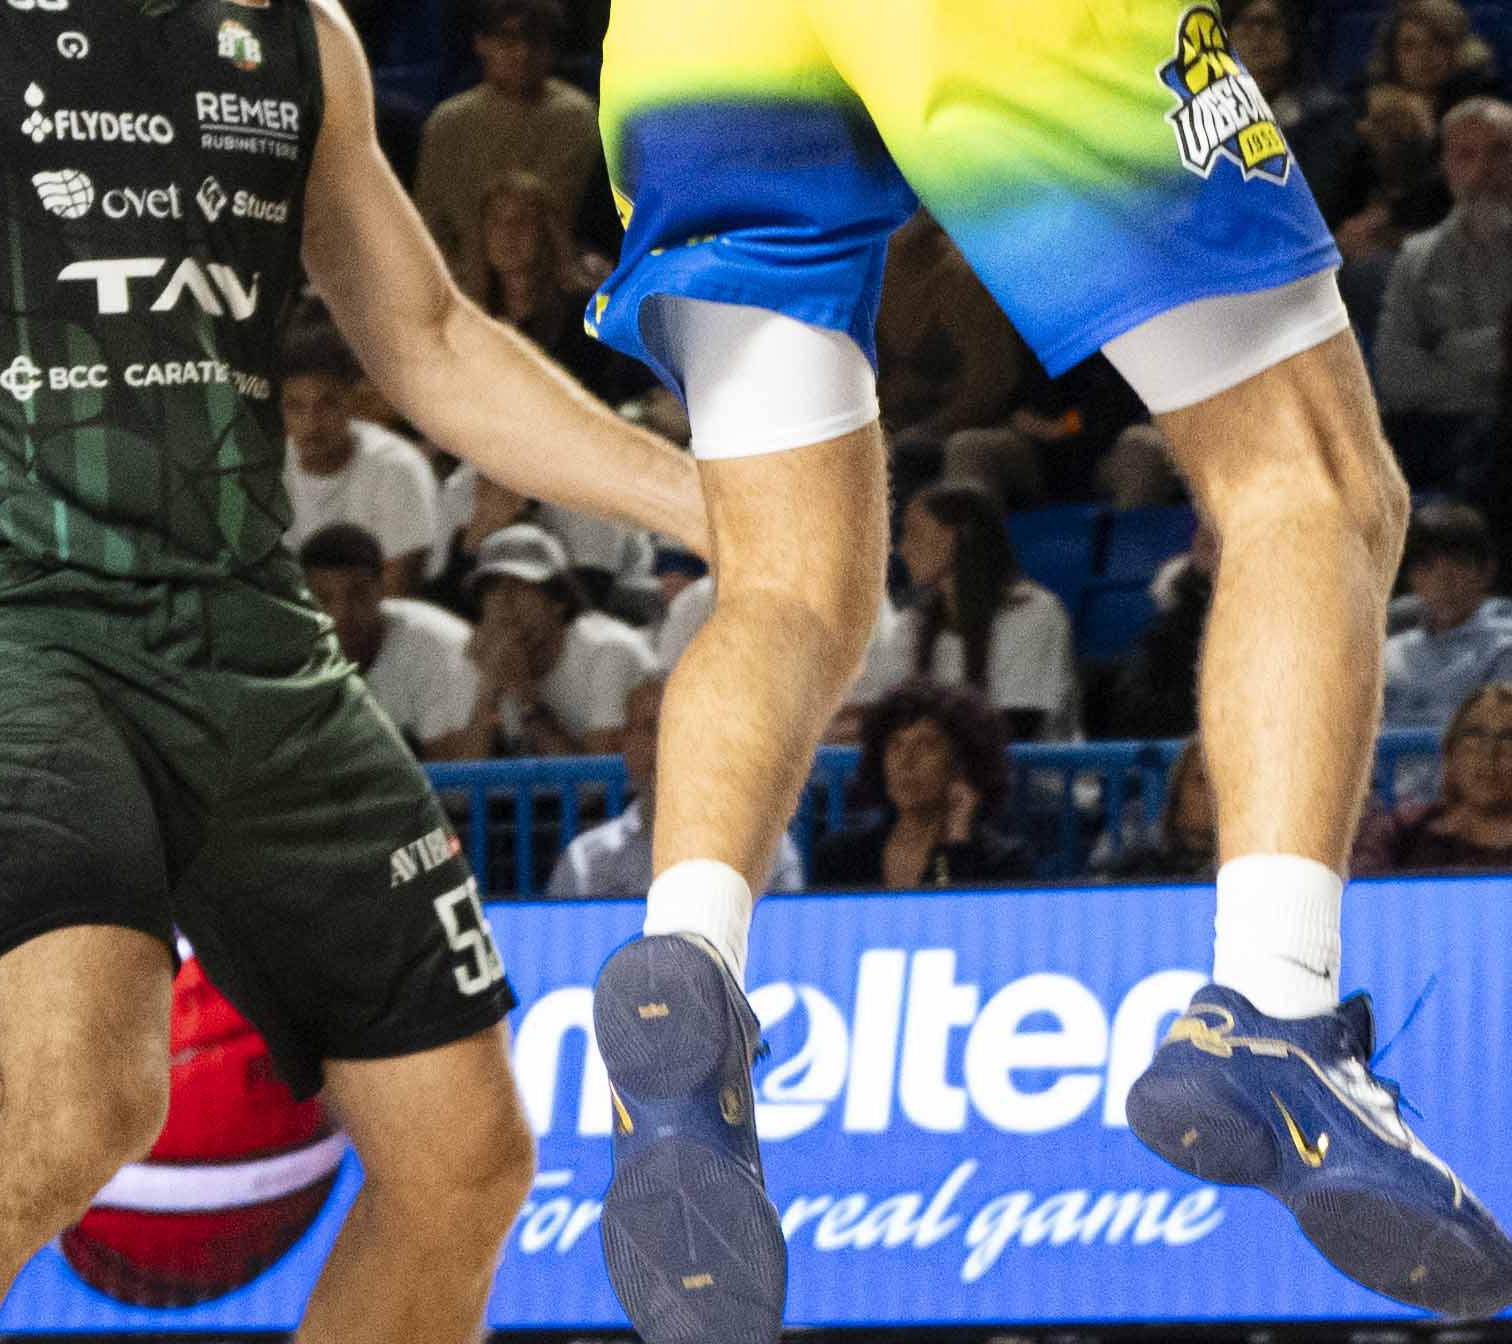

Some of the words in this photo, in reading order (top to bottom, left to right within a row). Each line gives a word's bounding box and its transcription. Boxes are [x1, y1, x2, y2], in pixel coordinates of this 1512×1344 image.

[55, 108, 174, 145] FLYDECO
[194, 90, 300, 132] REMER
[102, 181, 183, 220] ovet
[56, 256, 263, 321] TAV
[49, 364, 108, 389] BCC
[781, 1158, 981, 1252] real
[961, 1186, 1228, 1282] game
